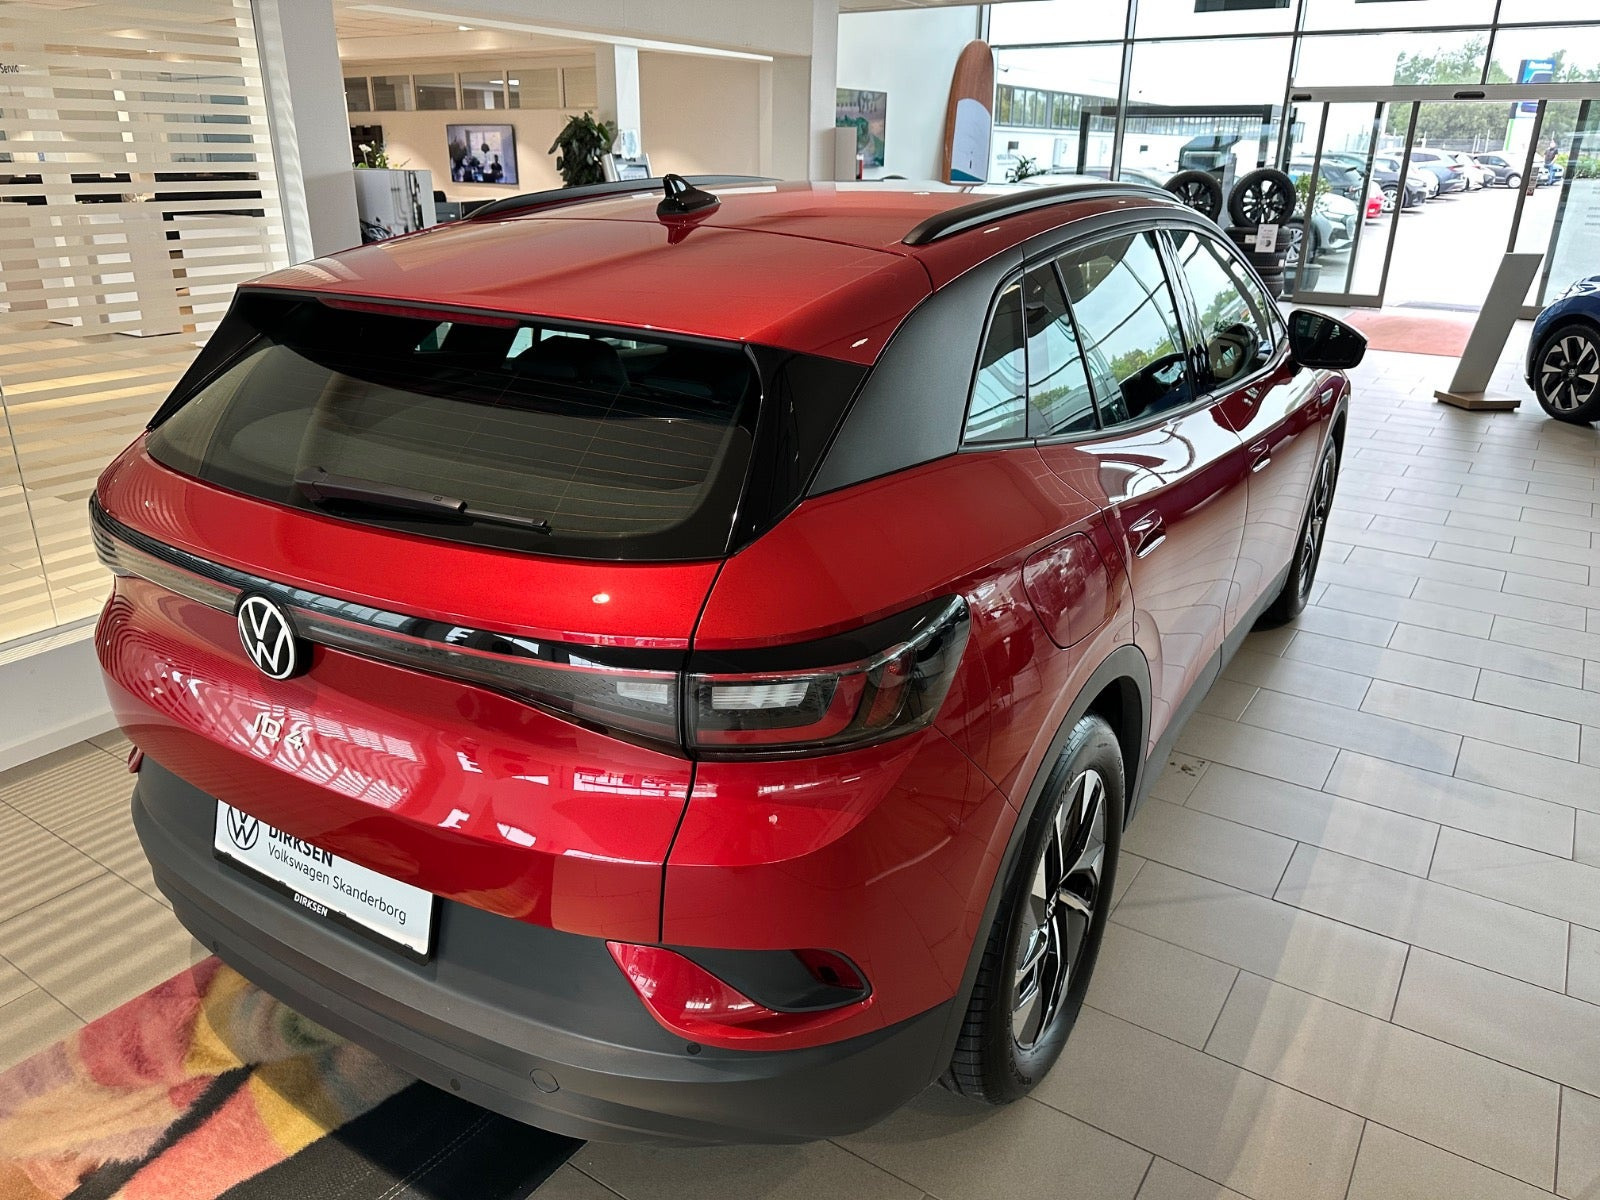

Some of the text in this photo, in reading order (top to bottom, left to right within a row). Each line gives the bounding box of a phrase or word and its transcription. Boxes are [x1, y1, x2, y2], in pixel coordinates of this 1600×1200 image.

[268, 825, 334, 868] DIRKSEN
[268, 842, 407, 925] Volkswagen Skanderborg
[293, 892, 329, 917] DIRKSEN
